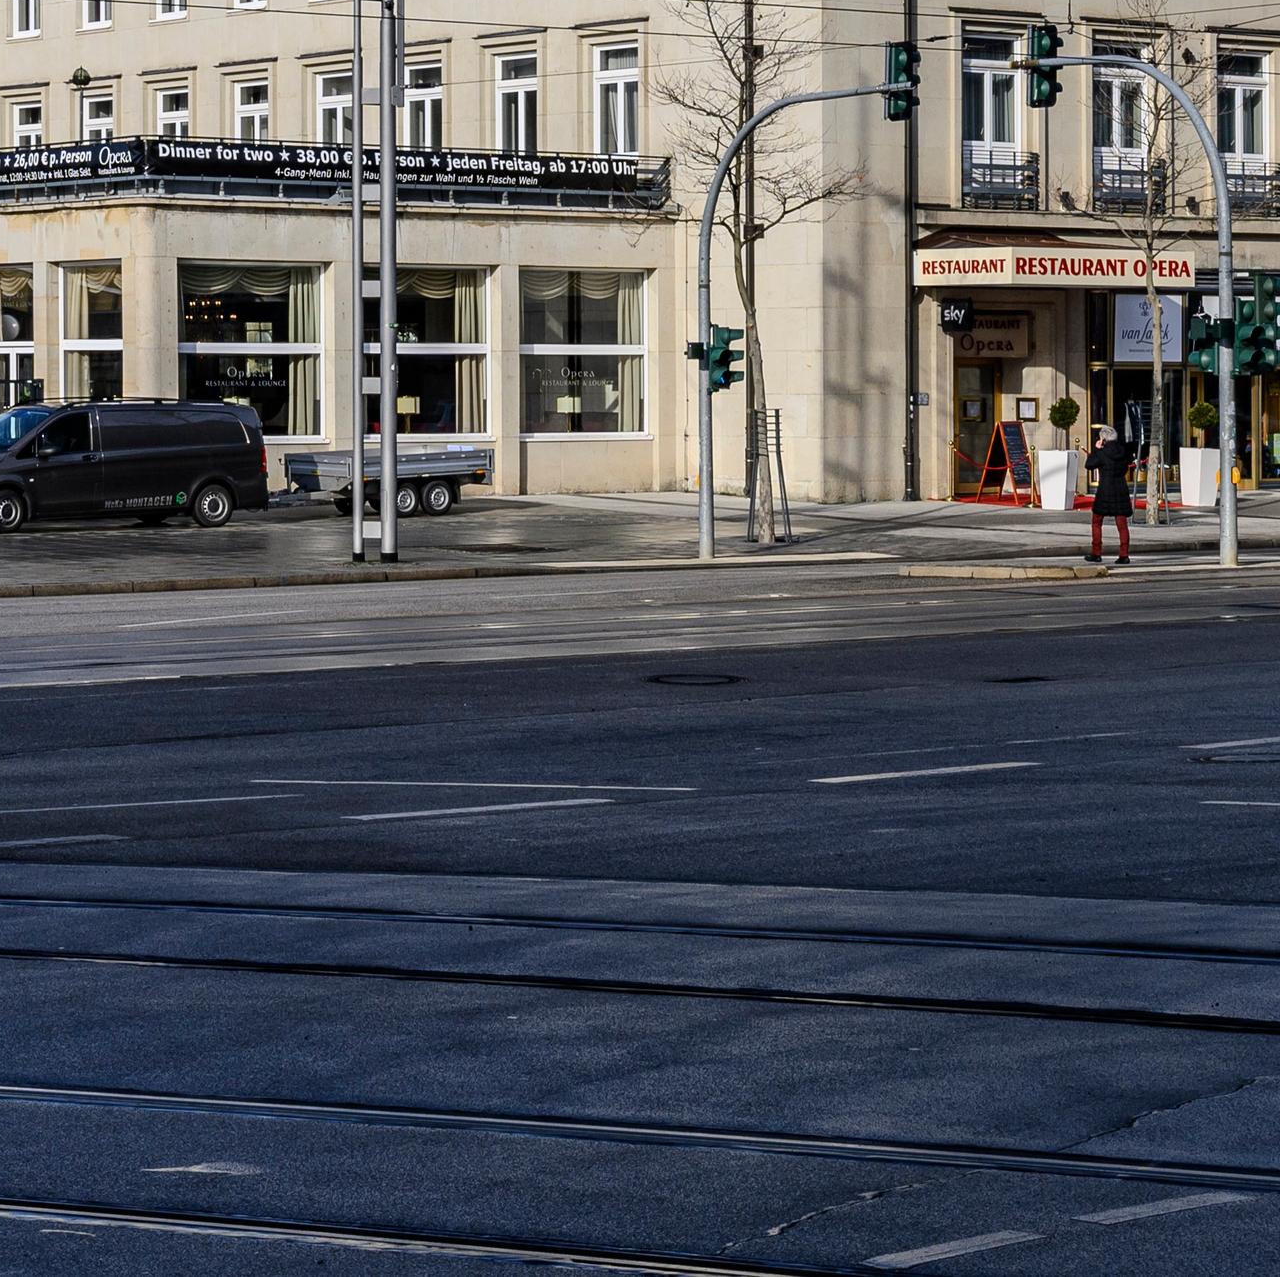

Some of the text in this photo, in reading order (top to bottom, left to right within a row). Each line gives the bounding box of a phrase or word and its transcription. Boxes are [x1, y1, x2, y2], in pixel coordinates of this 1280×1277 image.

[14, 153, 39, 169] 26,00
[41, 151, 49, 165] €
[49, 154, 59, 168] p.
[60, 150, 92, 164] Person
[158, 143, 211, 160] Dinner
[216, 145, 239, 161] for
[245, 147, 274, 162] two
[296, 149, 339, 166] 38,00
[343, 151, 353, 164] €
[446, 154, 487, 171] jeden
[491, 156, 545, 174] Freitag,
[549, 159, 566, 173] ab
[570, 161, 609, 175] 17:00
[613, 161, 637, 175] Uhr
[37, 171, 47, 180] Uhr
[275, 168, 331, 179] 4-Gang-Menü
[334, 169, 351, 179] inkl.
[420, 174, 433, 182] zur
[436, 173, 456, 182] Wahl
[458, 174, 473, 183] und
[487, 175, 516, 185] Flasche
[519, 176, 538, 185] Wein
[922, 258, 1006, 275] RESTAURANT
[1015, 257, 1128, 277] RESTAURANT
[944, 305, 965, 324] sky
[1121, 317, 1173, 346] van Lak
[126, 495, 173, 507] MONTAGEN
